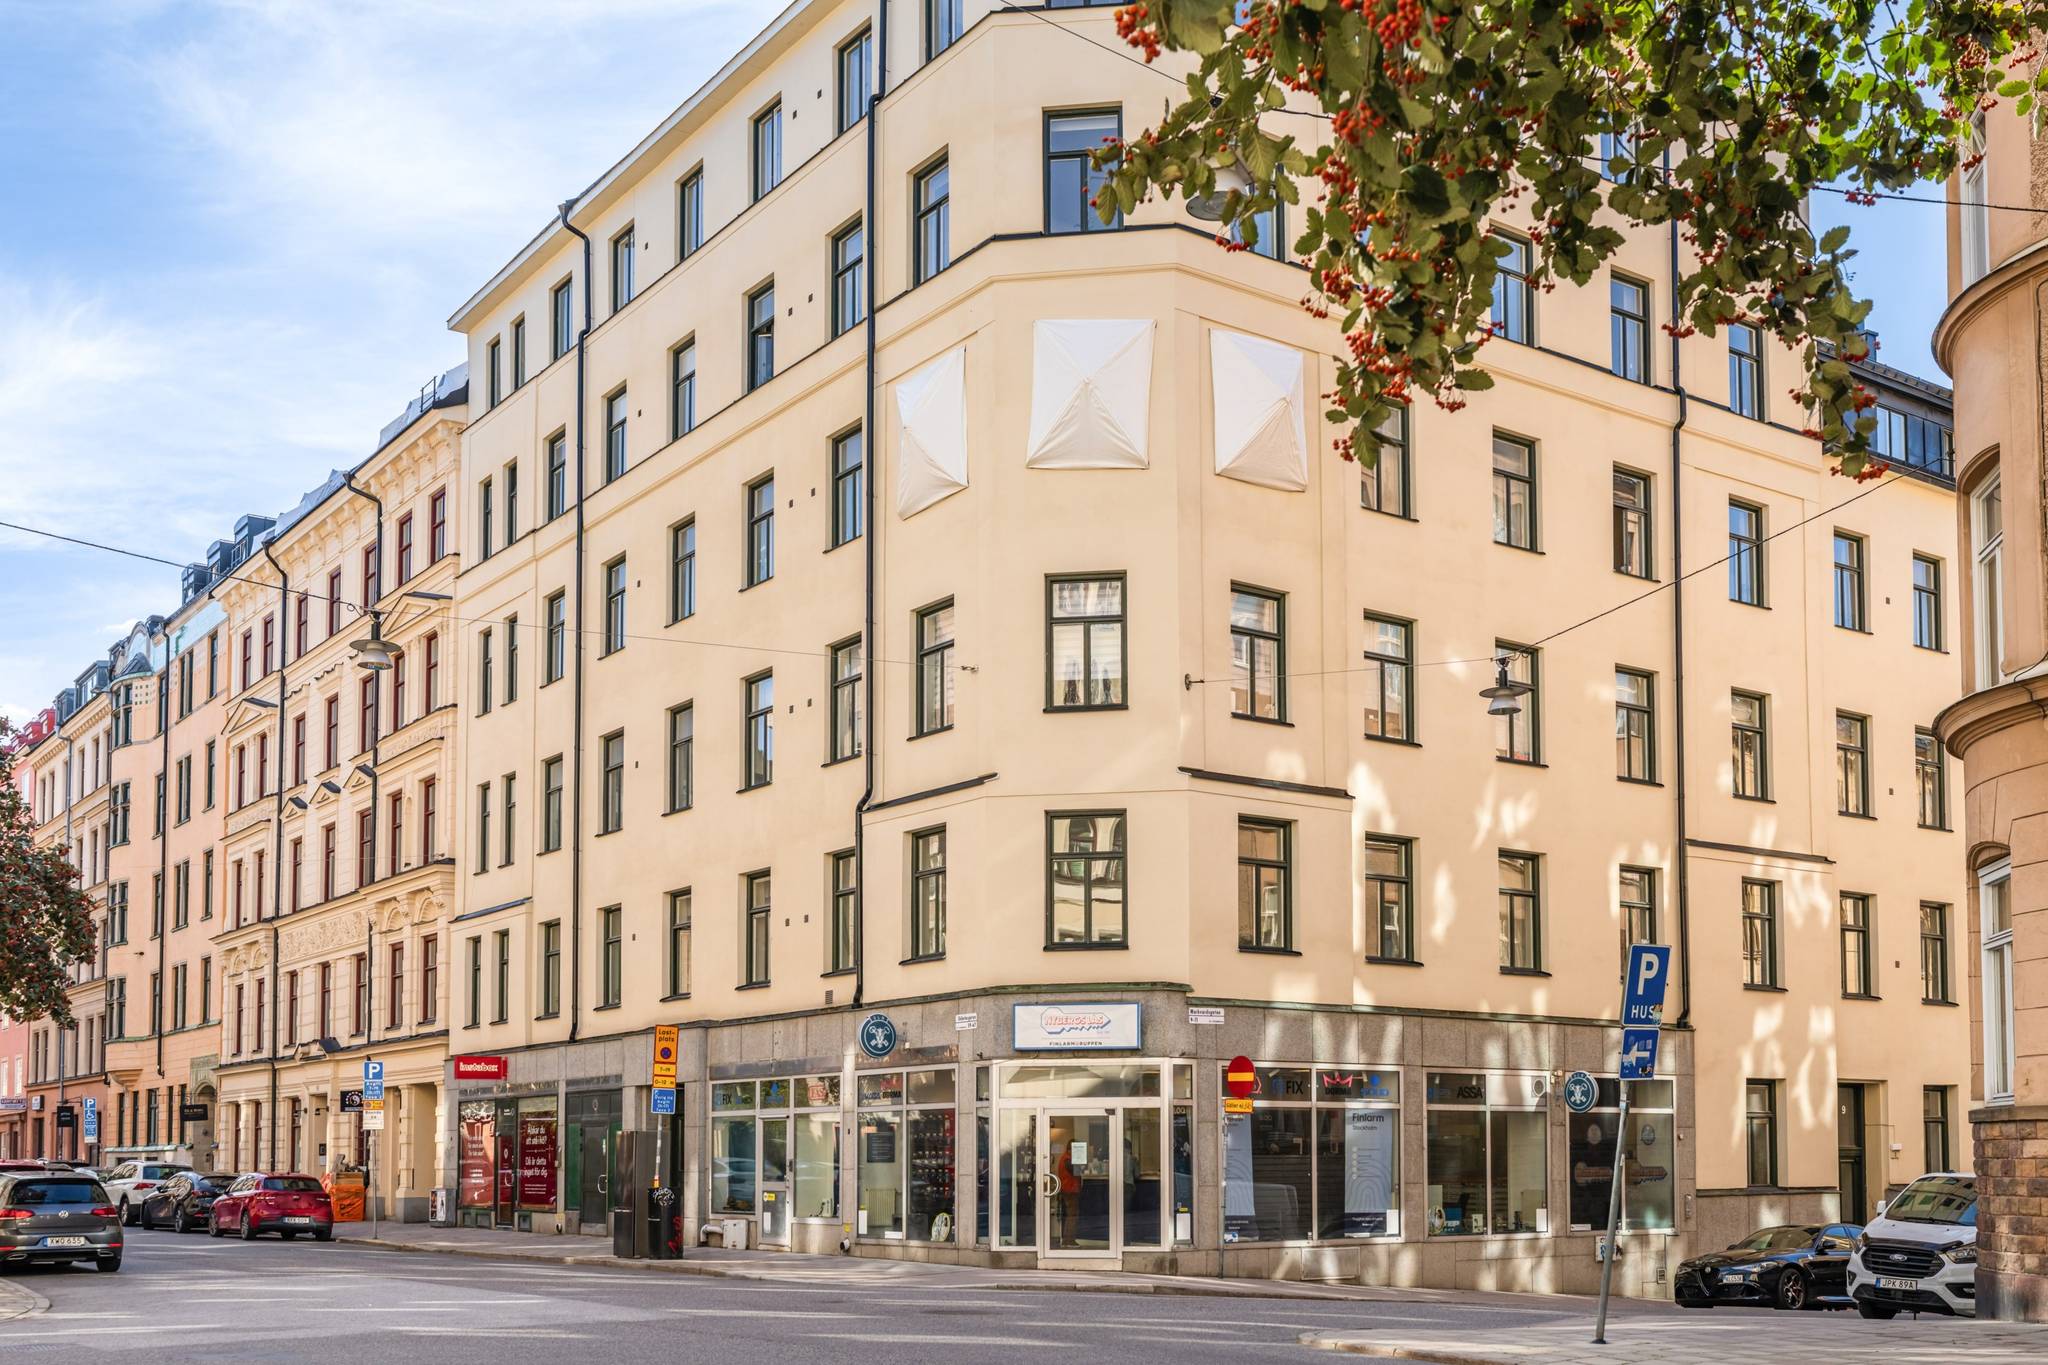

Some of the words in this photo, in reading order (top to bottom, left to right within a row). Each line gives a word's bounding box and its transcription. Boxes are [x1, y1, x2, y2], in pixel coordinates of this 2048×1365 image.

[1637, 952, 1660, 996] P
[1631, 1004, 1656, 1019] HUS
[1045, 1015, 1086, 1026] NYBERGS
[368, 1063, 381, 1079] P
[459, 1062, 499, 1072] instabox
[1286, 1081, 1304, 1095] FIX
[1457, 1086, 1483, 1099] ASSA
[87, 1099, 94, 1108] P
[722, 1093, 732, 1104] FIX
[1841, 1104, 1847, 1115] 9
[1352, 1112, 1385, 1122] Finlarm
[1882, 1279, 1897, 1288] JPK
[1898, 1280, 1914, 1289] 89A
